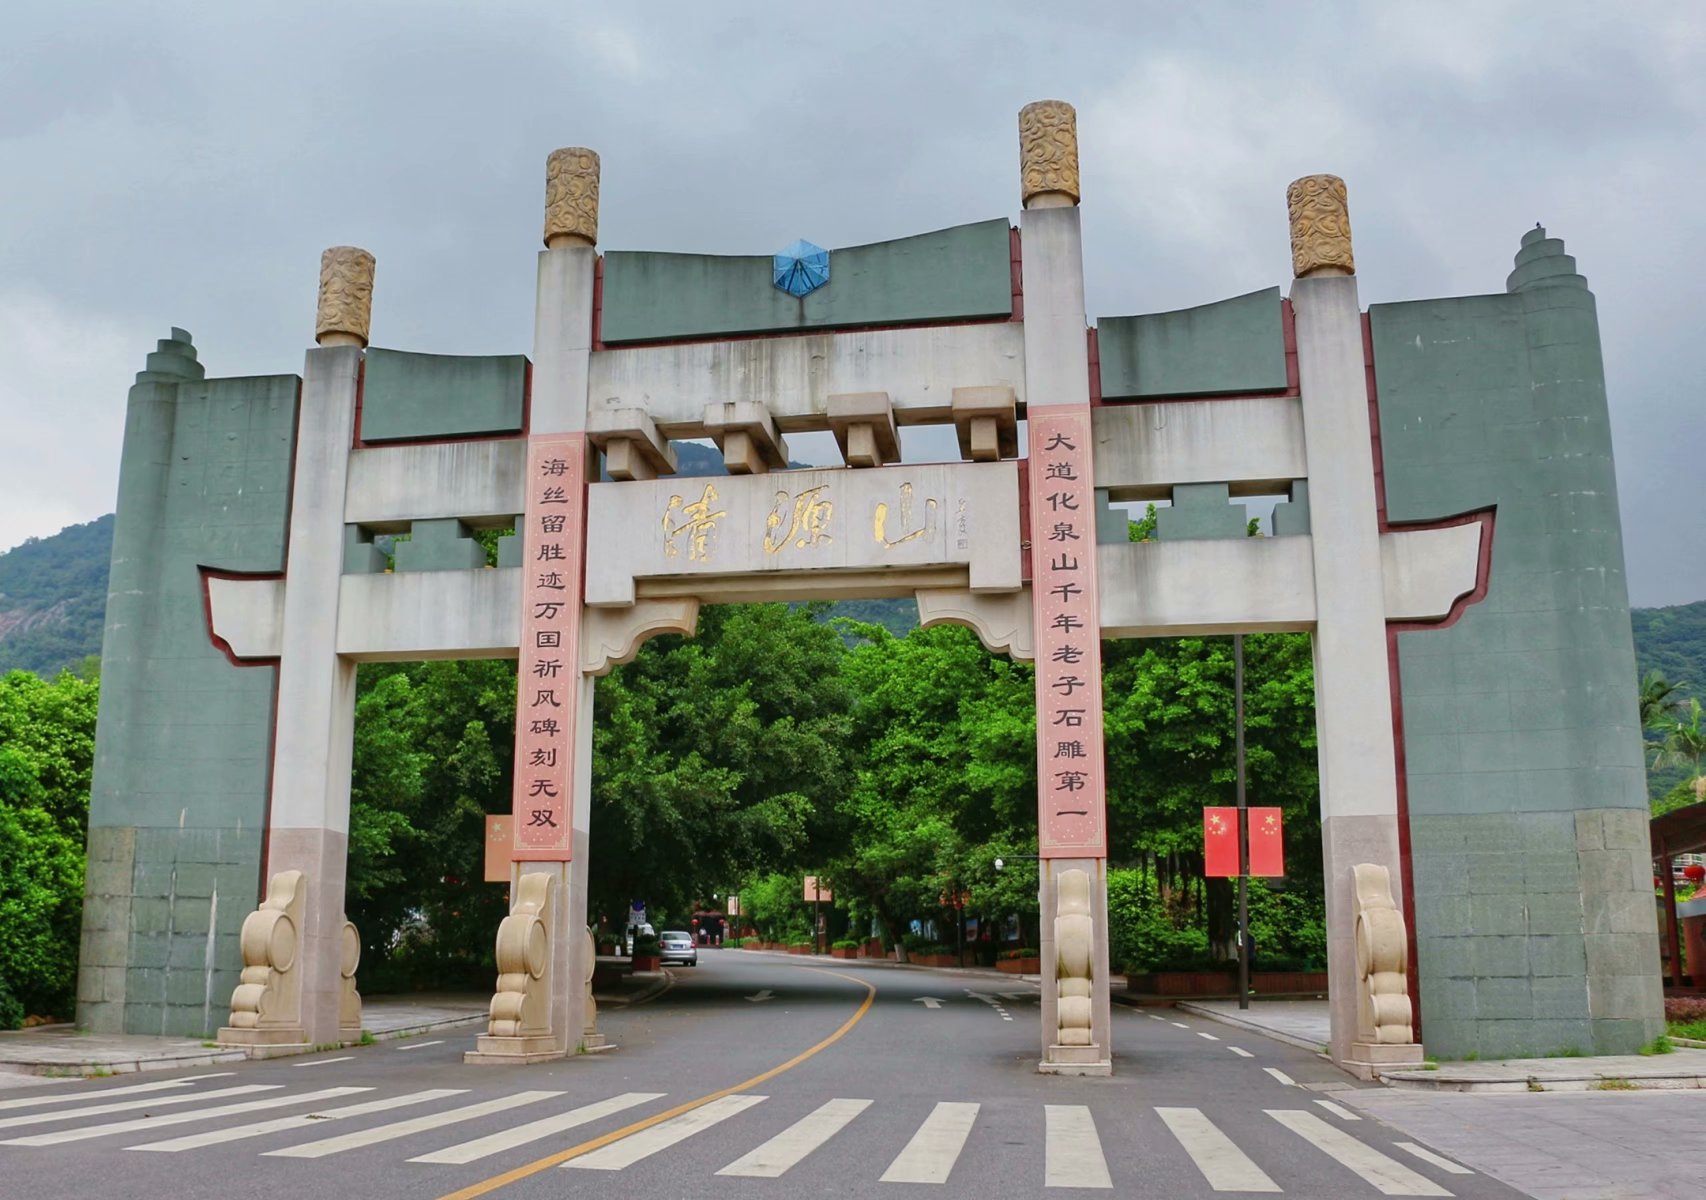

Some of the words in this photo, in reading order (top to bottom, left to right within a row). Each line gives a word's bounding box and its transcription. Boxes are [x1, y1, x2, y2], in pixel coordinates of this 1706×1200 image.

[527, 458, 570, 828] 海丝留胜迹万国祈风碑刻无双
[661, 481, 938, 562] 清源山
[1044, 432, 1088, 817] 大道化泉山千年老子石雕第一
